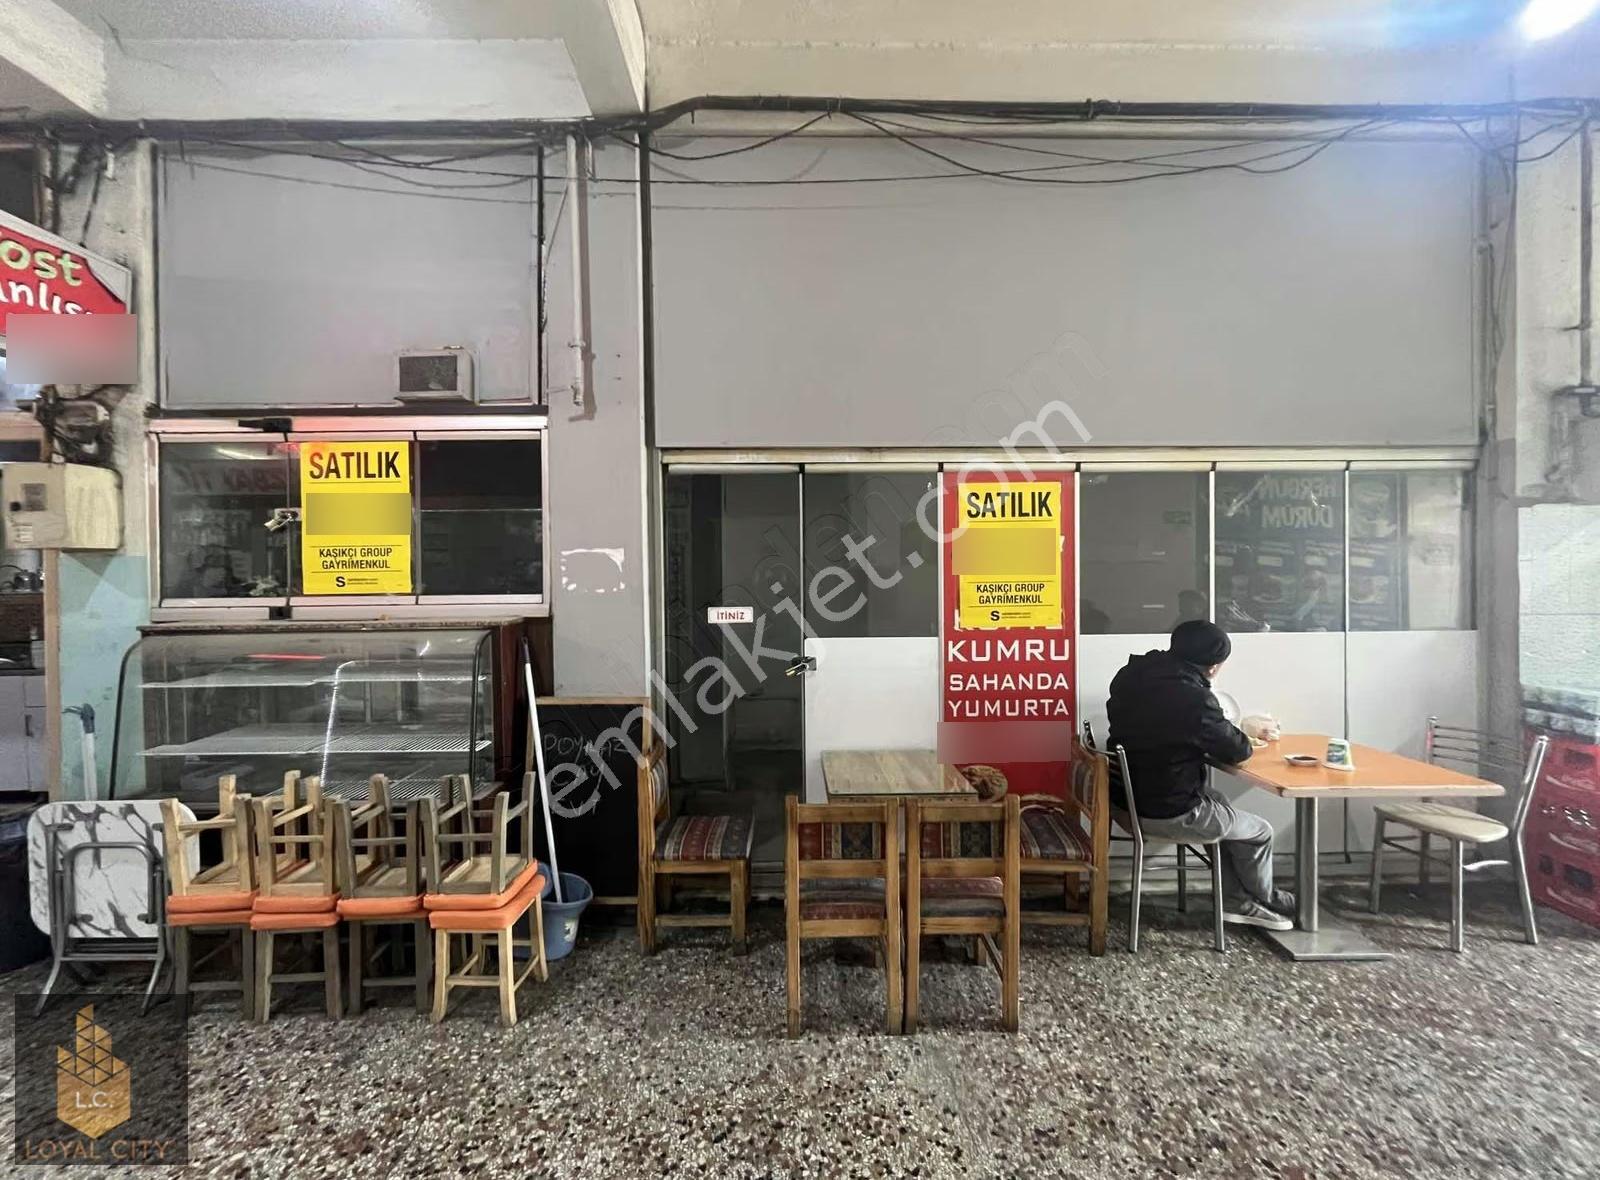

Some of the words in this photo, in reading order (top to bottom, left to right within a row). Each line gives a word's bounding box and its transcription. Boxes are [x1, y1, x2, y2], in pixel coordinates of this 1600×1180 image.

[0, 231, 82, 286] ost
[309, 451, 401, 480] SATILIK
[966, 491, 1053, 519] SATILIK
[319, 548, 358, 562] KAŞIKÇI
[360, 547, 393, 557] GROUP
[321, 557, 391, 571] GAYRİMENKUL
[976, 583, 1013, 596] KAŞIKÇI
[1014, 582, 1046, 593] GROUP
[978, 592, 1044, 605] GAYRİMENKUL
[947, 638, 1070, 662] KUMRU
[949, 672, 1070, 692] SAHANDA
[948, 698, 1070, 718] YUMURTA
